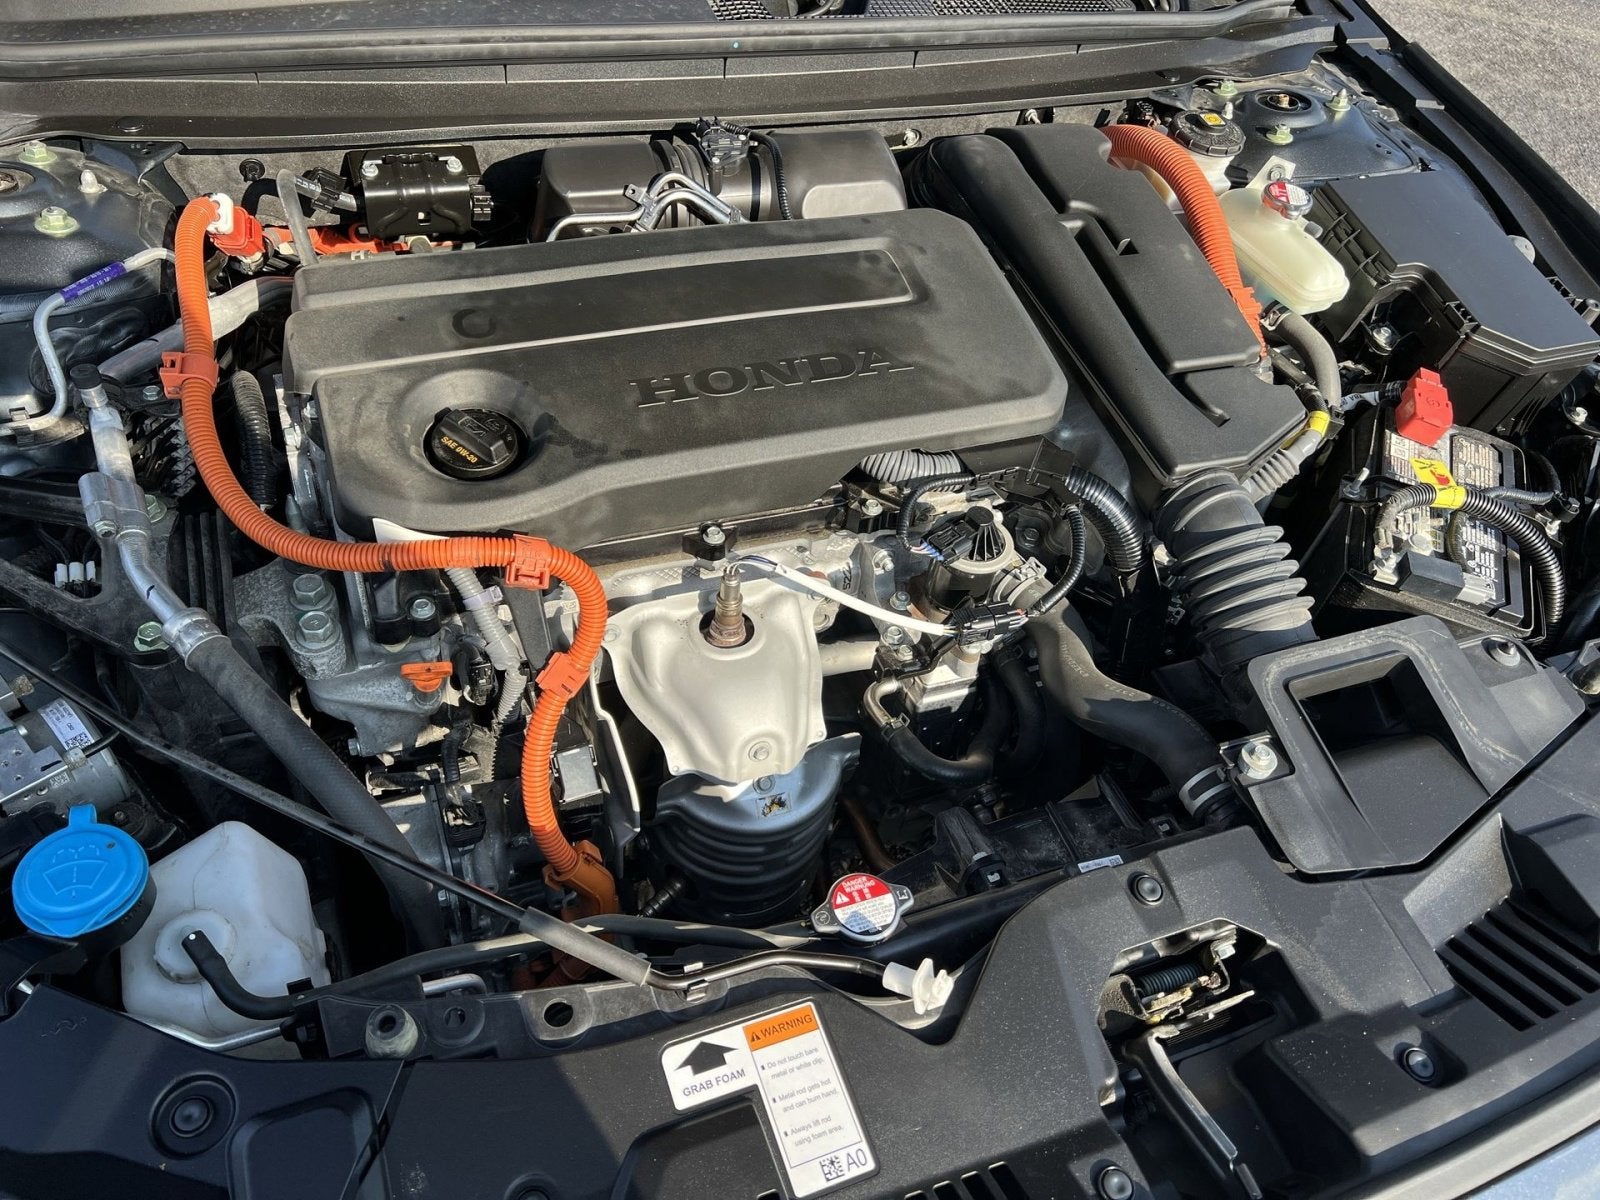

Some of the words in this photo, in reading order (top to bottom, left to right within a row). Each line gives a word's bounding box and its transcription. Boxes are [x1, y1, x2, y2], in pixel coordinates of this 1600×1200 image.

[629, 349, 915, 407] HONDA
[441, 436, 458, 450] SAE
[456, 447, 478, 463] 0W-20
[842, 876, 867, 888] DANGER
[761, 1014, 813, 1038] WARNING
[777, 1057, 788, 1065] not
[787, 1052, 805, 1062] touch
[771, 1068, 788, 1080] metal
[796, 1062, 812, 1071] white
[682, 1078, 714, 1098] GRAB
[714, 1068, 747, 1087] FOAM
[778, 1090, 796, 1100] Metal
[796, 1086, 807, 1096] rod
[820, 1078, 832, 1087] hot
[783, 1103, 795, 1113] and
[795, 1100, 807, 1108] can
[790, 1124, 812, 1136] Always
[820, 1115, 832, 1125] rod
[794, 1136, 812, 1147] using
[846, 1148, 868, 1172] A0
